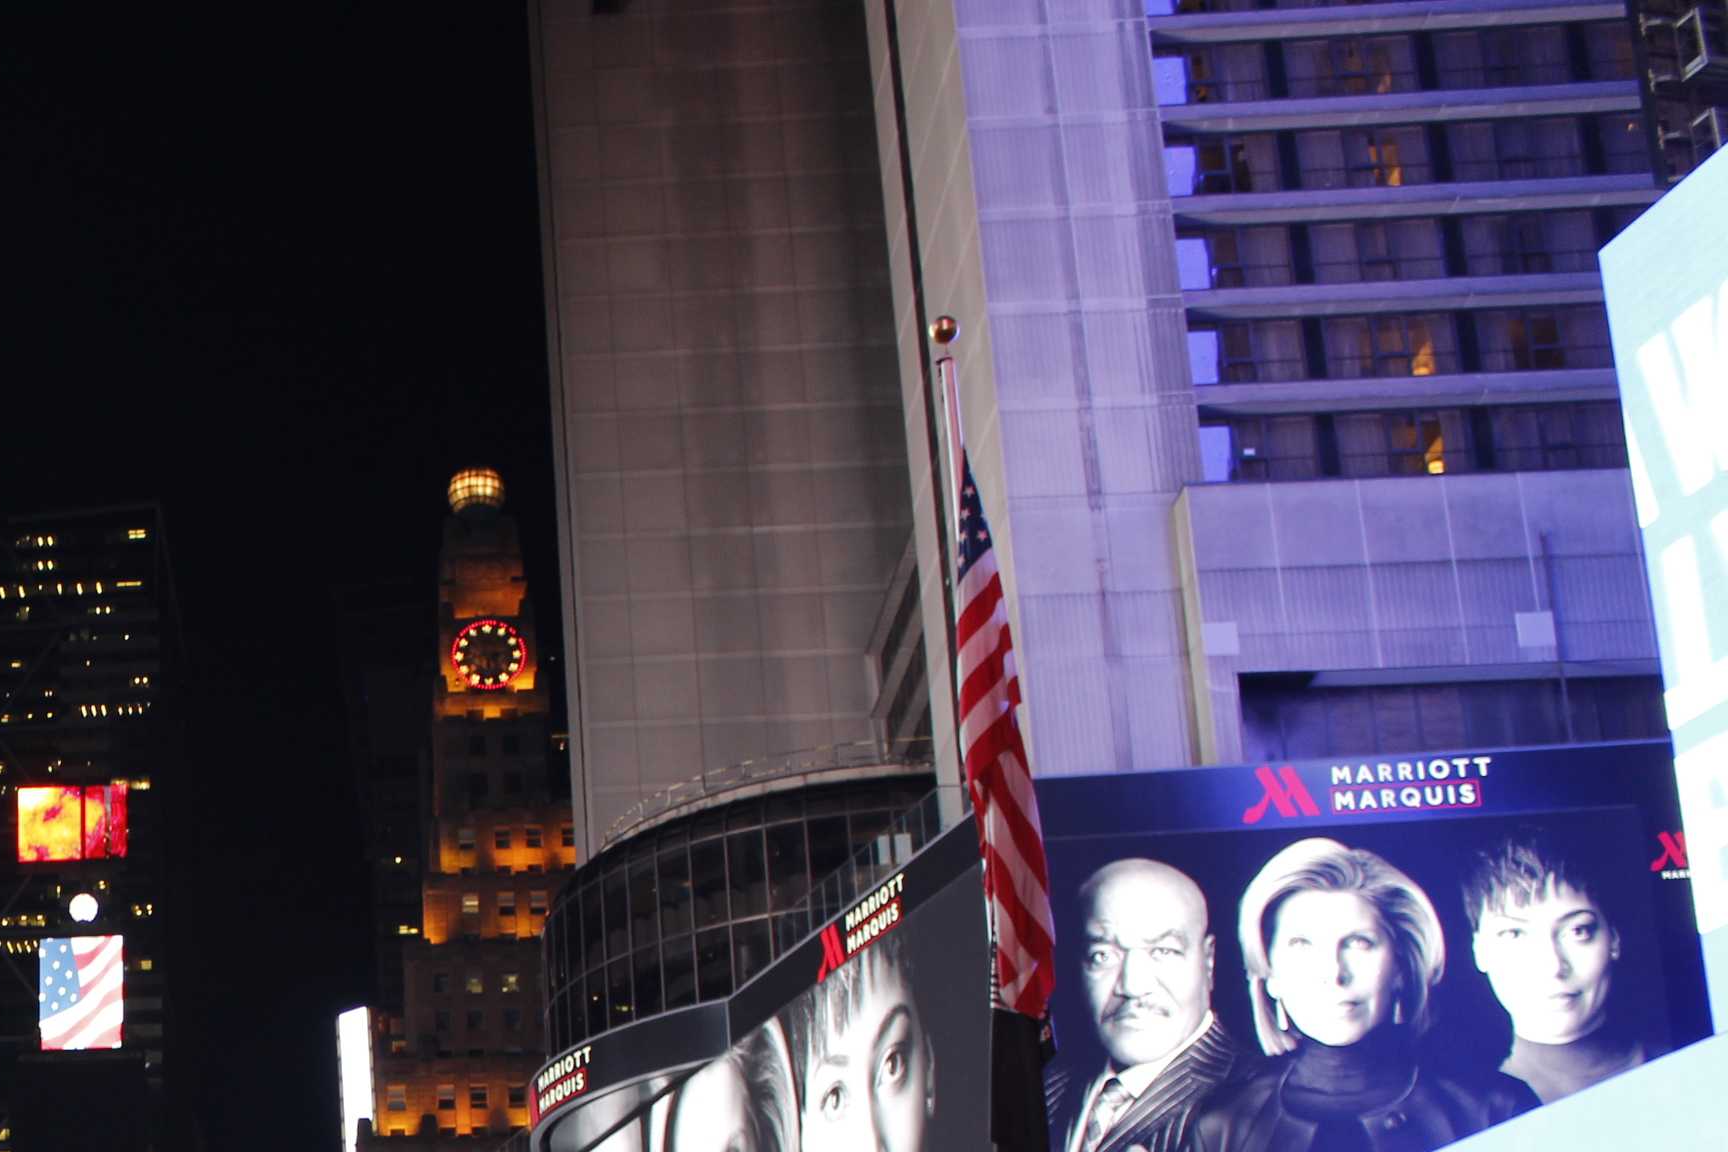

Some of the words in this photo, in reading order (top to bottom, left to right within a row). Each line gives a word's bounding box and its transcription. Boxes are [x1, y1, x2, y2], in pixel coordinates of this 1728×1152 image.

[1331, 756, 1493, 785] MARRIOTT
[1333, 784, 1477, 812] MARQUIS
[845, 873, 904, 931] MARRIOTT
[847, 903, 899, 954] MARQUIS
[537, 1045, 591, 1094] MARRIOTT
[539, 1072, 585, 1115] MARQUIS
